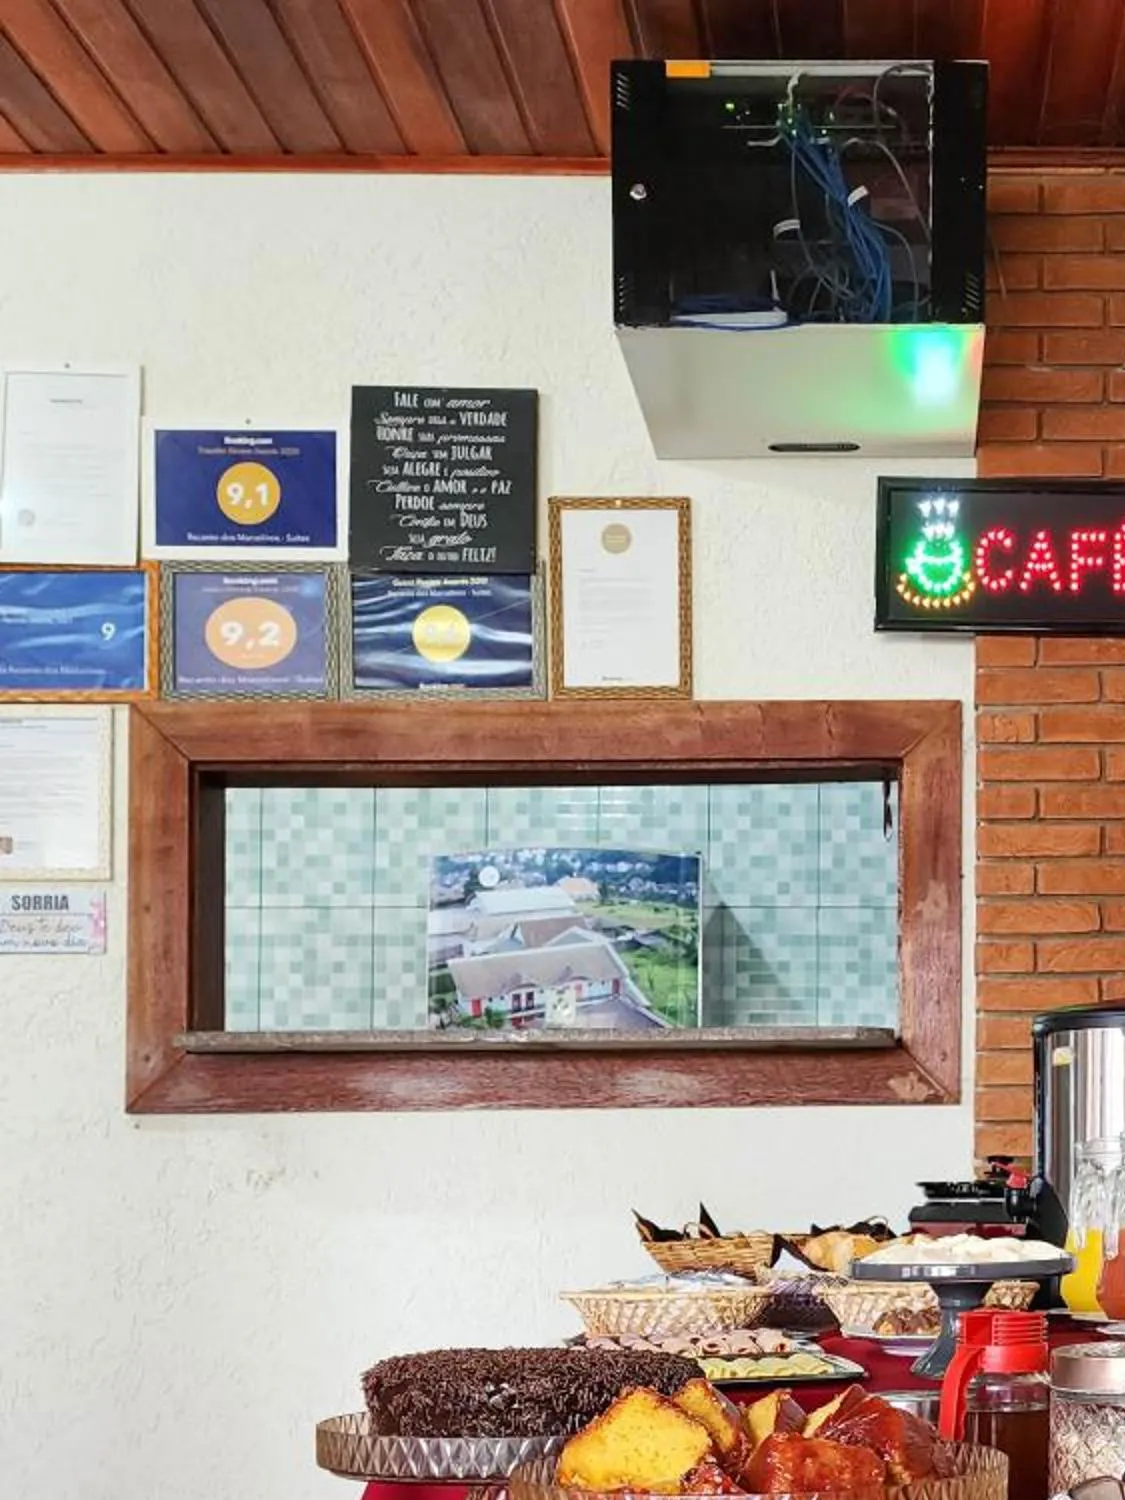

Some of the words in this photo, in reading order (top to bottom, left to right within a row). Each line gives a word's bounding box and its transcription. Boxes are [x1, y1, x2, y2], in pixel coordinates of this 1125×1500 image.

[394, 391, 419, 408] FALE
[459, 411, 508, 427] VERDADE
[376, 426, 414, 441] HONRE
[451, 445, 493, 461] JULGAR
[402, 461, 441, 477] ALEGRE
[432, 479, 467, 495] AMOR
[491, 479, 512, 495] PAZ
[226, 482, 268, 510] 9,1
[395, 494, 435, 511] PERDOE
[459, 510, 488, 528] DEUS
[462, 547, 497, 563] FELIZ!
[101, 621, 117, 641] 9
[220, 621, 281, 652] 9,2
[12, 894, 69, 912] SORRIA
